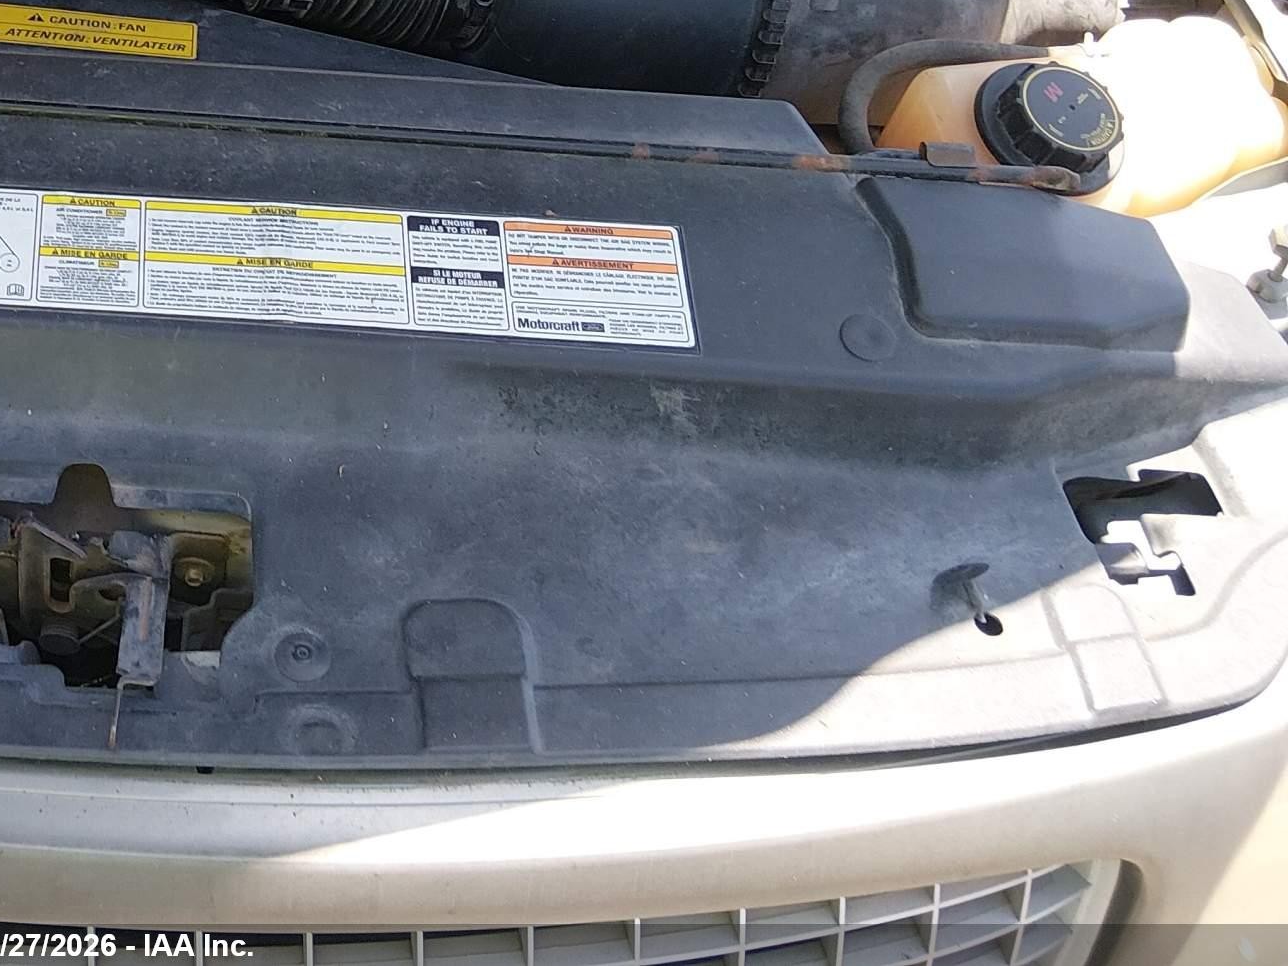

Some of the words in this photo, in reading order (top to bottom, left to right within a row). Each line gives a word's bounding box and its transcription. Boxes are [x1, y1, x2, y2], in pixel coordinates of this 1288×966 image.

[118, 22, 147, 33] FAN
[92, 35, 187, 52] VENTILATEUR
[78, 198, 115, 207] CAUTION
[259, 207, 297, 217] CAUTION
[430, 218, 440, 226] IF
[441, 219, 475, 227] ENGINE
[419, 224, 444, 232] FAILS
[460, 227, 488, 235] START
[572, 225, 614, 235] WARNING
[98, 251, 128, 259] GARDE
[284, 260, 313, 268] GARDE
[561, 259, 633, 270] AVERTISSEMENT
[452, 271, 482, 279] MOTEUR
[417, 276, 446, 284] REFUSE
[447, 277, 457, 285] DE
[517, 317, 581, 332] Motorcraft
